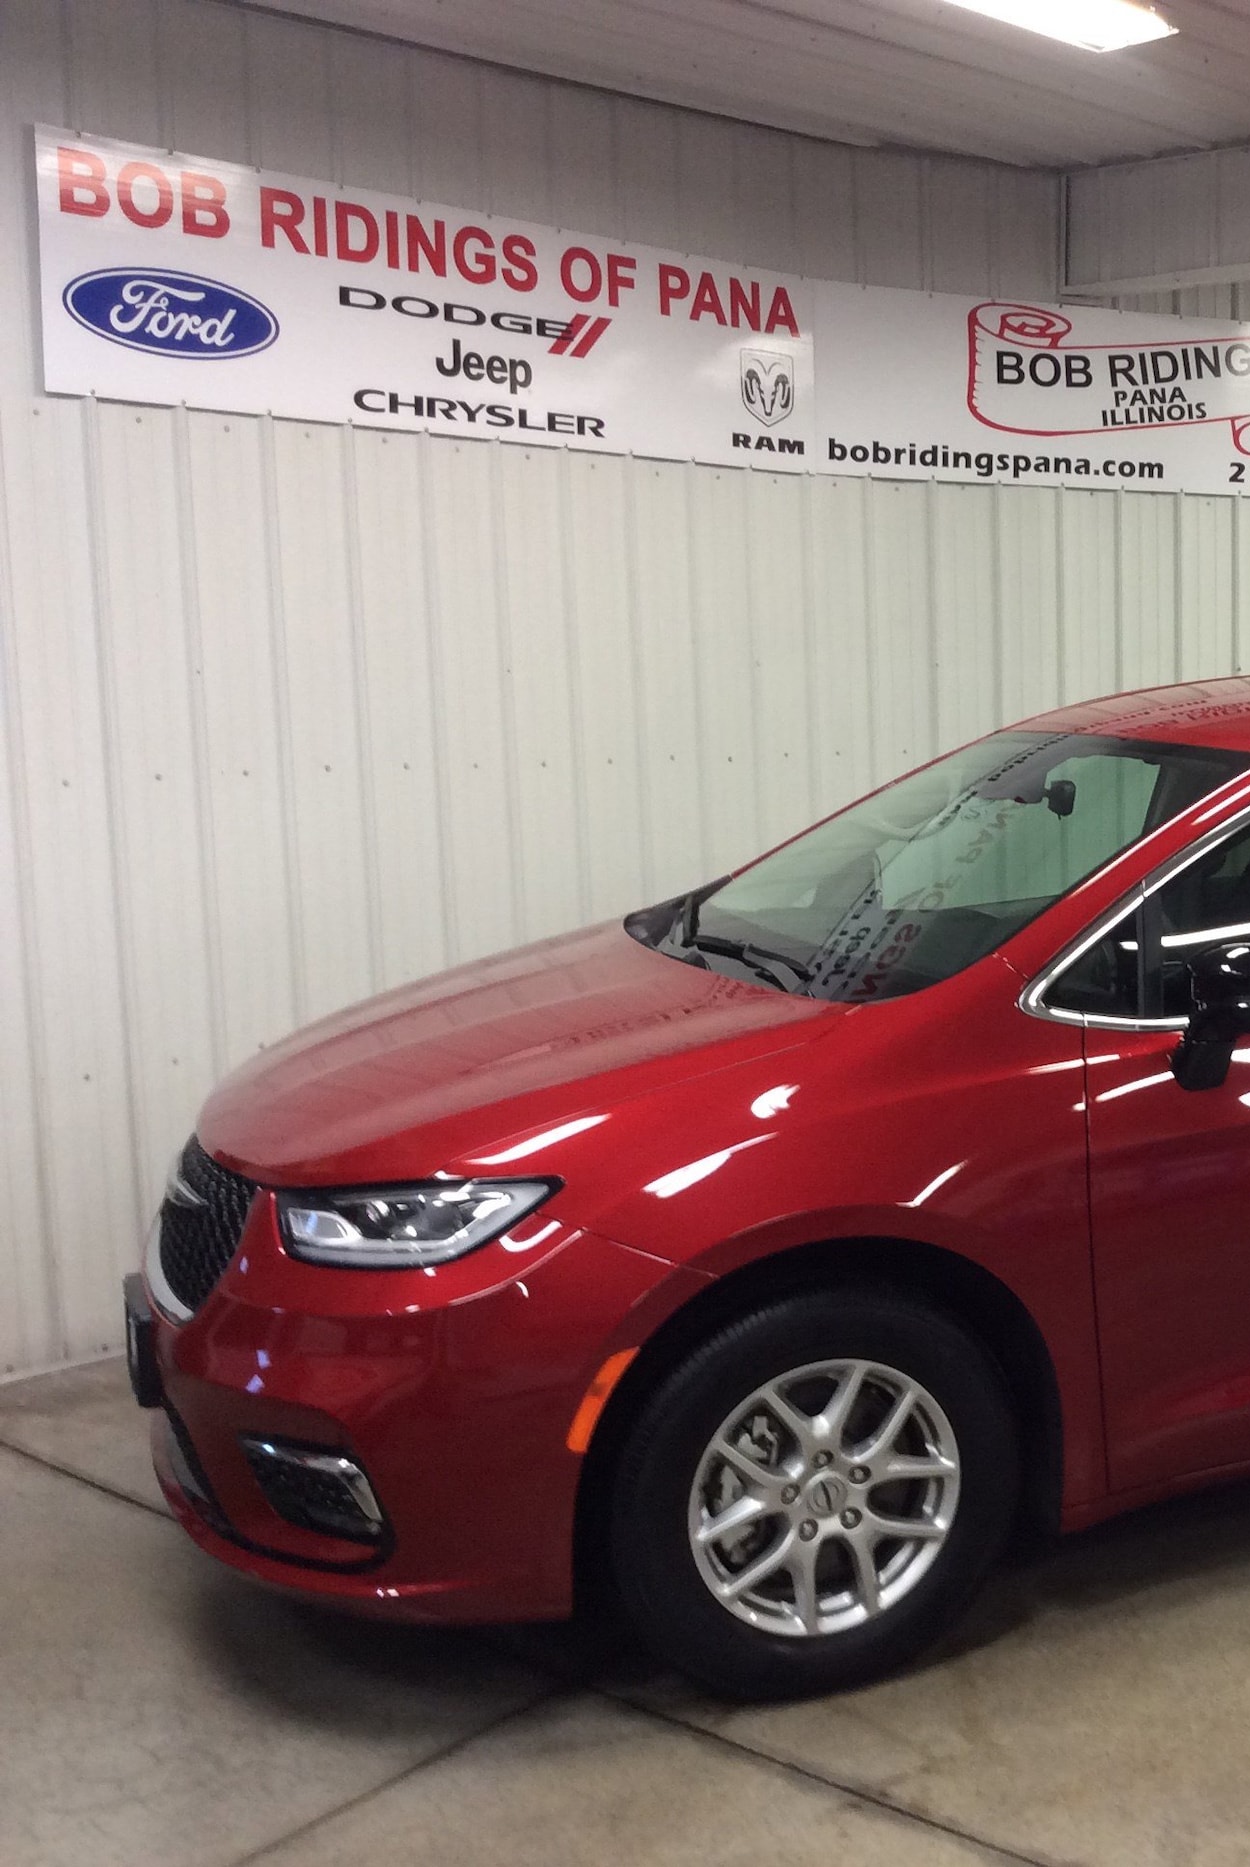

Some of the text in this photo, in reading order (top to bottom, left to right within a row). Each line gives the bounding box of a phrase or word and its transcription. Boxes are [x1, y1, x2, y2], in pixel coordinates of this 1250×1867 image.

[56, 145, 802, 339] BOB RIDINGS OF PANA
[110, 279, 237, 347] Ford
[339, 285, 575, 341] DODGE
[435, 338, 533, 394] Jeep
[995, 350, 1094, 388] BOB
[353, 389, 606, 438] CHRYSLER
[1101, 402, 1208, 427] ILLINOIS
[1113, 386, 1188, 408] PANA
[732, 432, 806, 455] RAM
[828, 438, 1165, 481] bobridingspana.com
